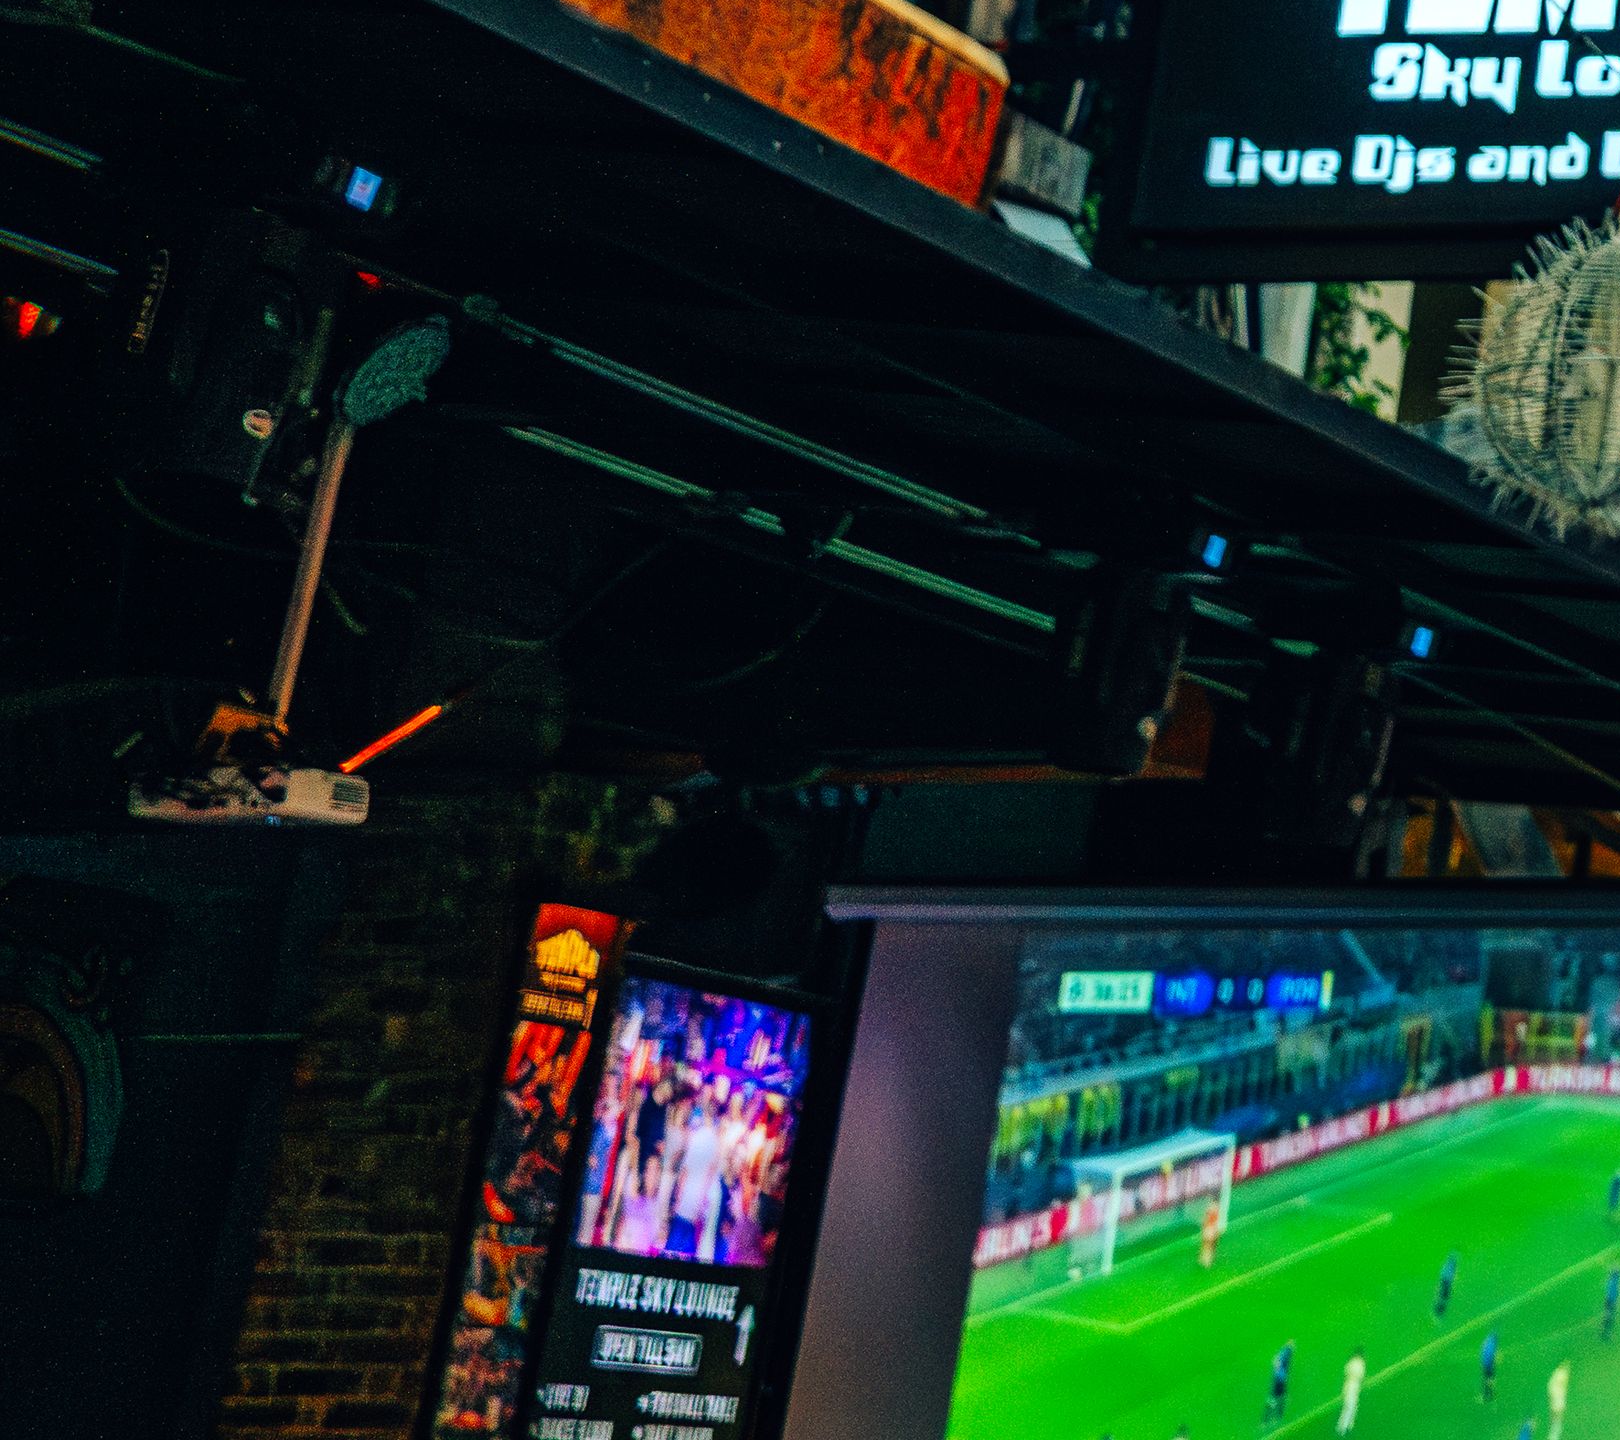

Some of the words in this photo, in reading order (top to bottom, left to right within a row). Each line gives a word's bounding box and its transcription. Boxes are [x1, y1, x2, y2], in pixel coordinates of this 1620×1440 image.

[1369, 42, 1521, 114] Sky
[1205, 135, 1341, 187] Live
[1351, 135, 1456, 194] Djs
[1466, 132, 1589, 187] and
